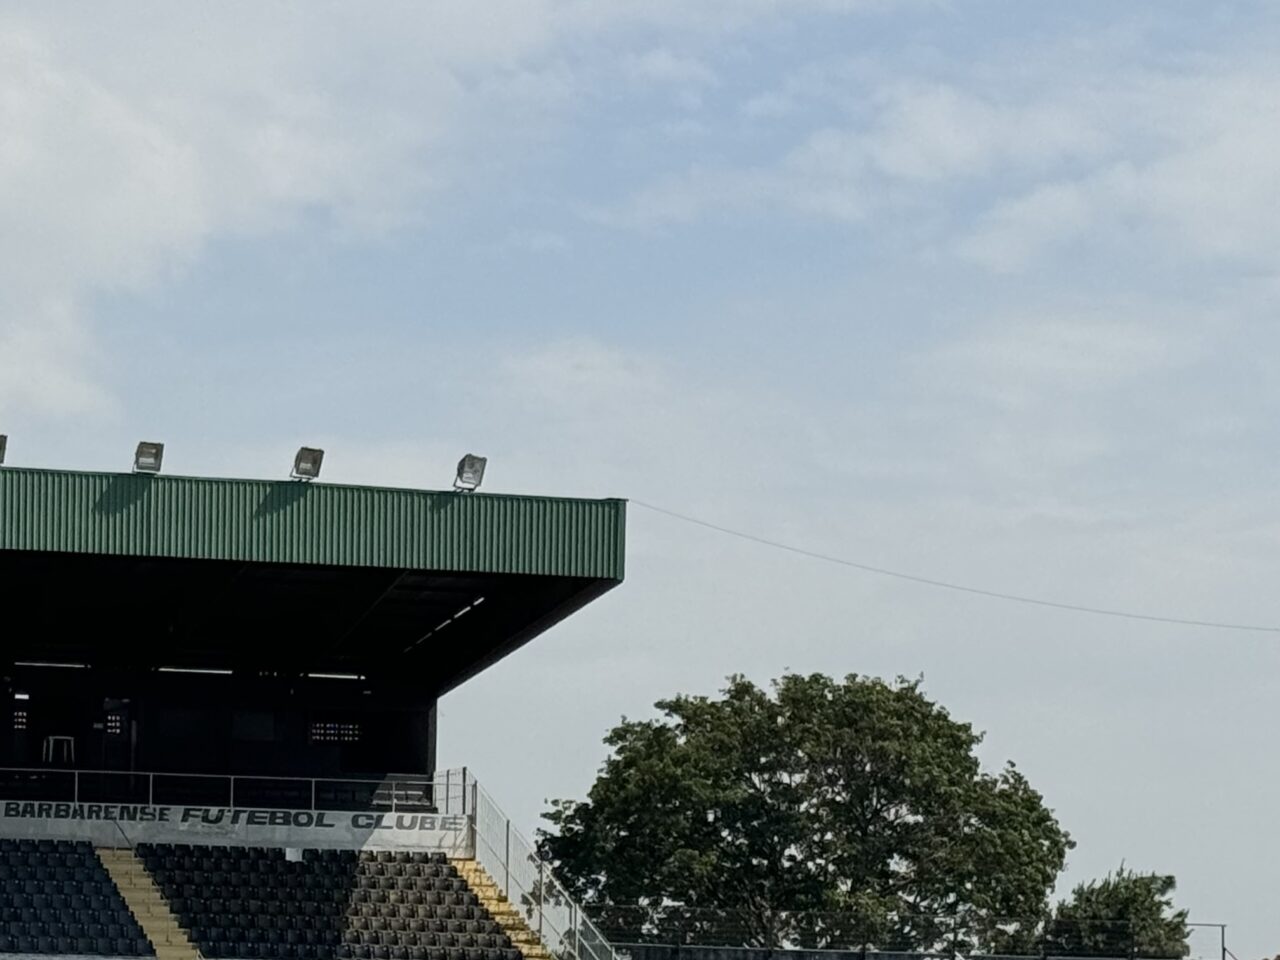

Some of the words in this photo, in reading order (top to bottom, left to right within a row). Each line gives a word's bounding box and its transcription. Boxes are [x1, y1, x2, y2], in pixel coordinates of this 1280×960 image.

[4, 801, 171, 823] BARBARENSE
[181, 807, 335, 828] FUTEBOL
[351, 813, 464, 832] CLUBE
